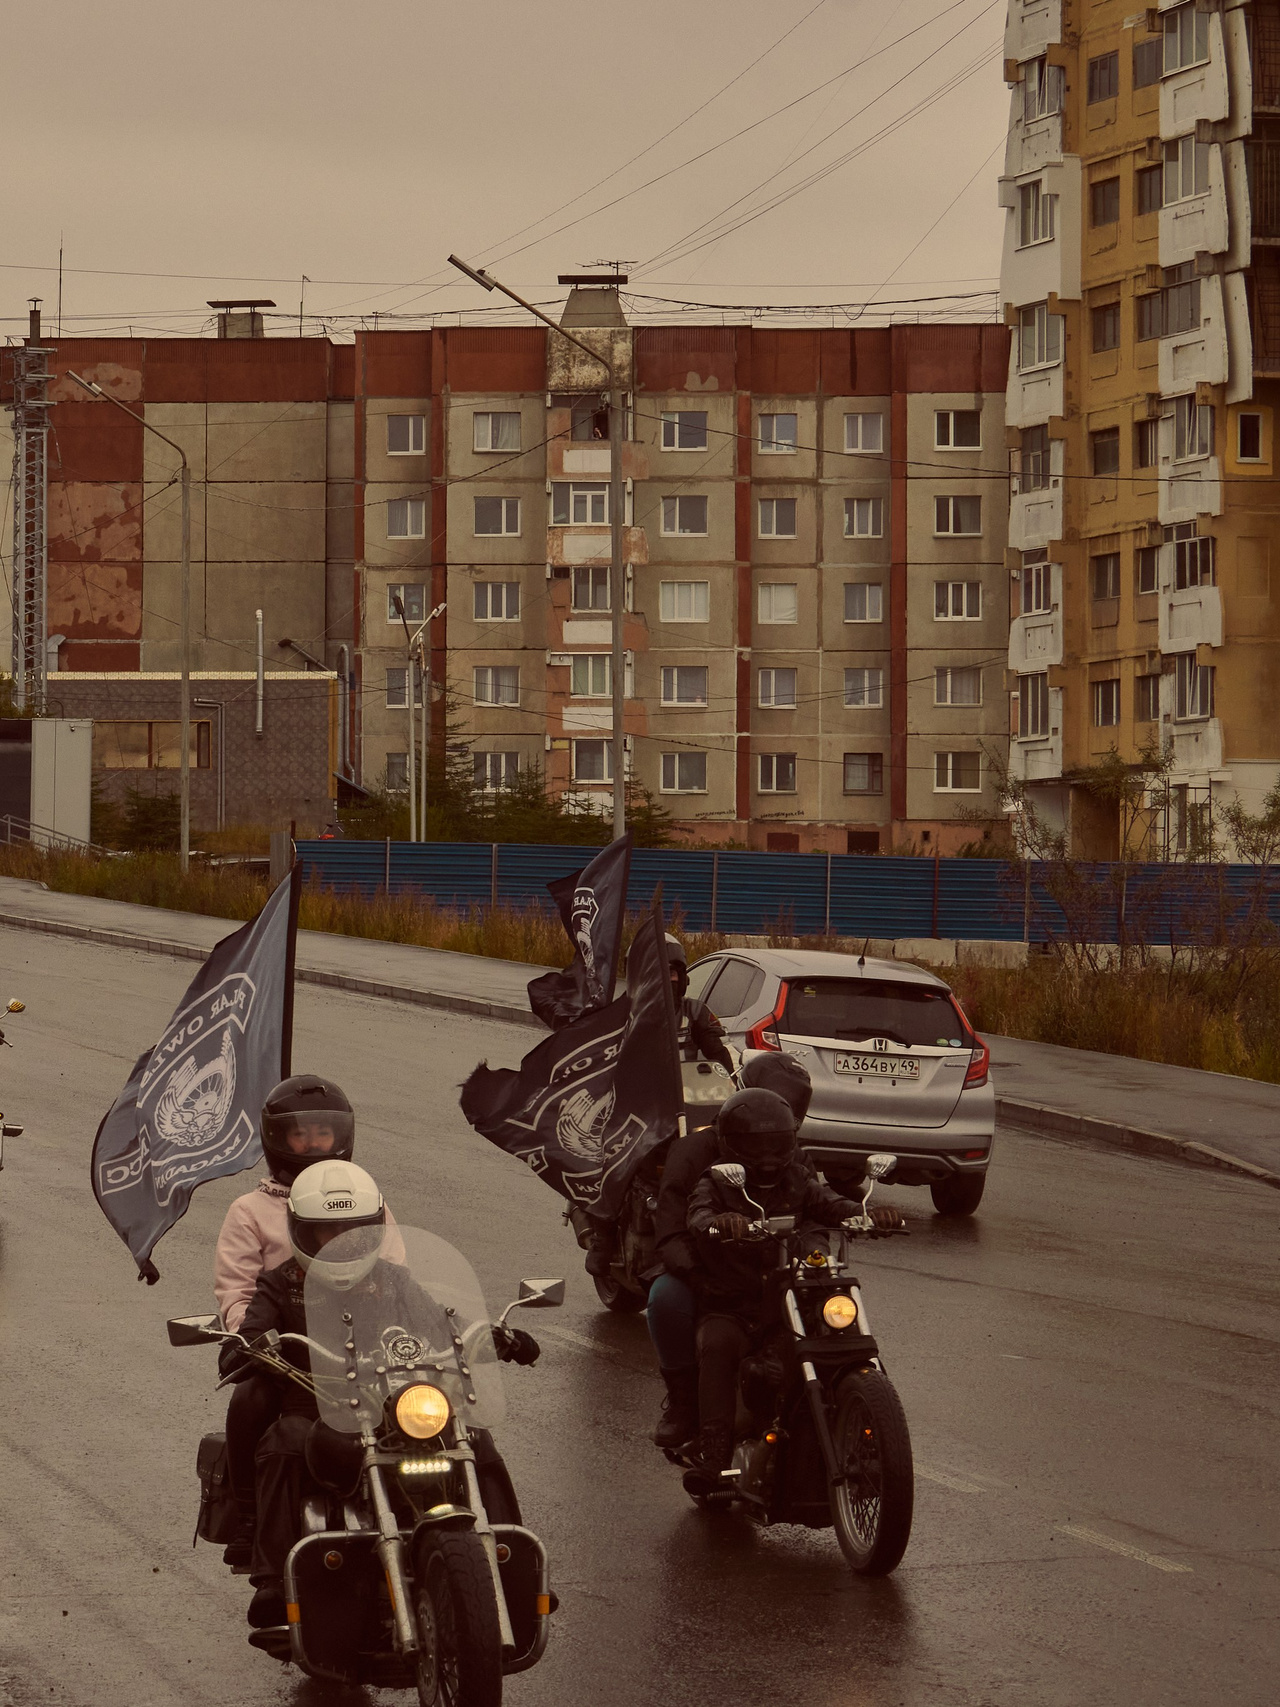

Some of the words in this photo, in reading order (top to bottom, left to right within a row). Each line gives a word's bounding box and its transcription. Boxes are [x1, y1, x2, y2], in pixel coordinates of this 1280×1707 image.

[787, 1049, 811, 1058] FIT
[841, 1056, 897, 1073] А364ВУ
[901, 1060, 915, 1072] 49
[327, 1200, 352, 1210] SHOEI
